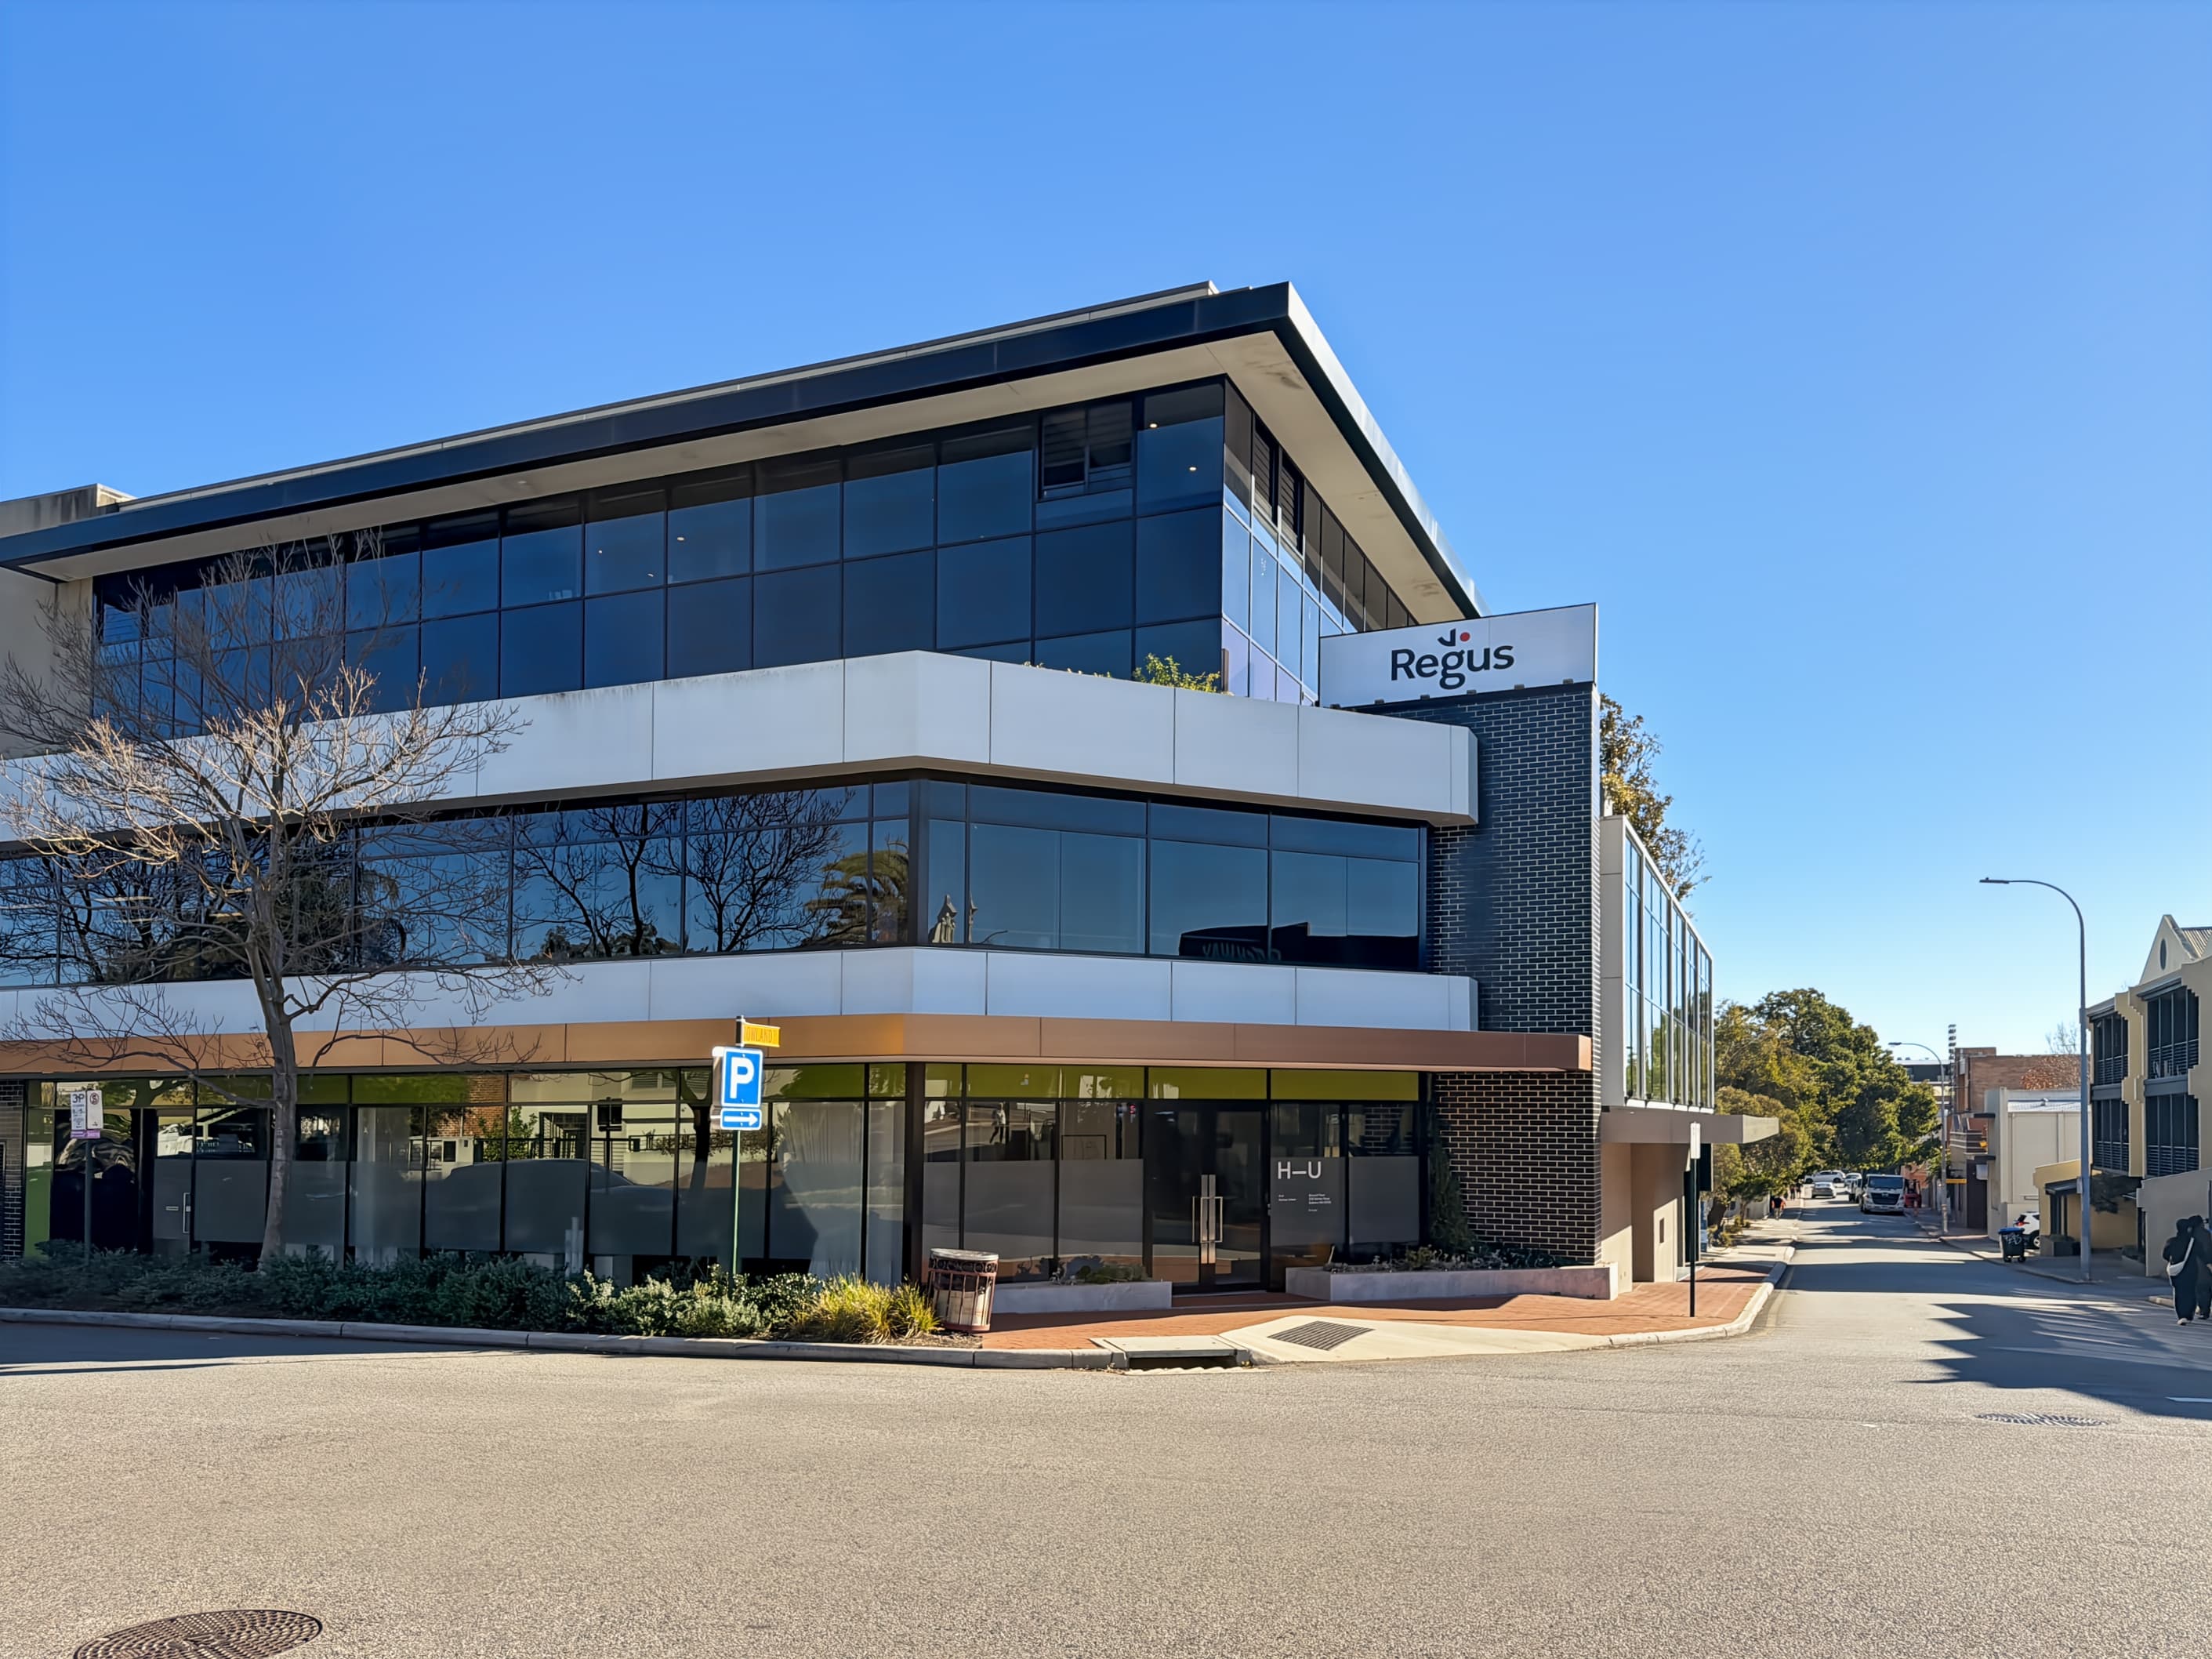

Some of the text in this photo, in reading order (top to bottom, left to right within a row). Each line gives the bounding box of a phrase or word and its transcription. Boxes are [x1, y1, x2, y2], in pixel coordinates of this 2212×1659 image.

[1391, 644, 1514, 690] Regus
[72, 1093, 85, 1103] 3P
[730, 1056, 755, 1099] P
